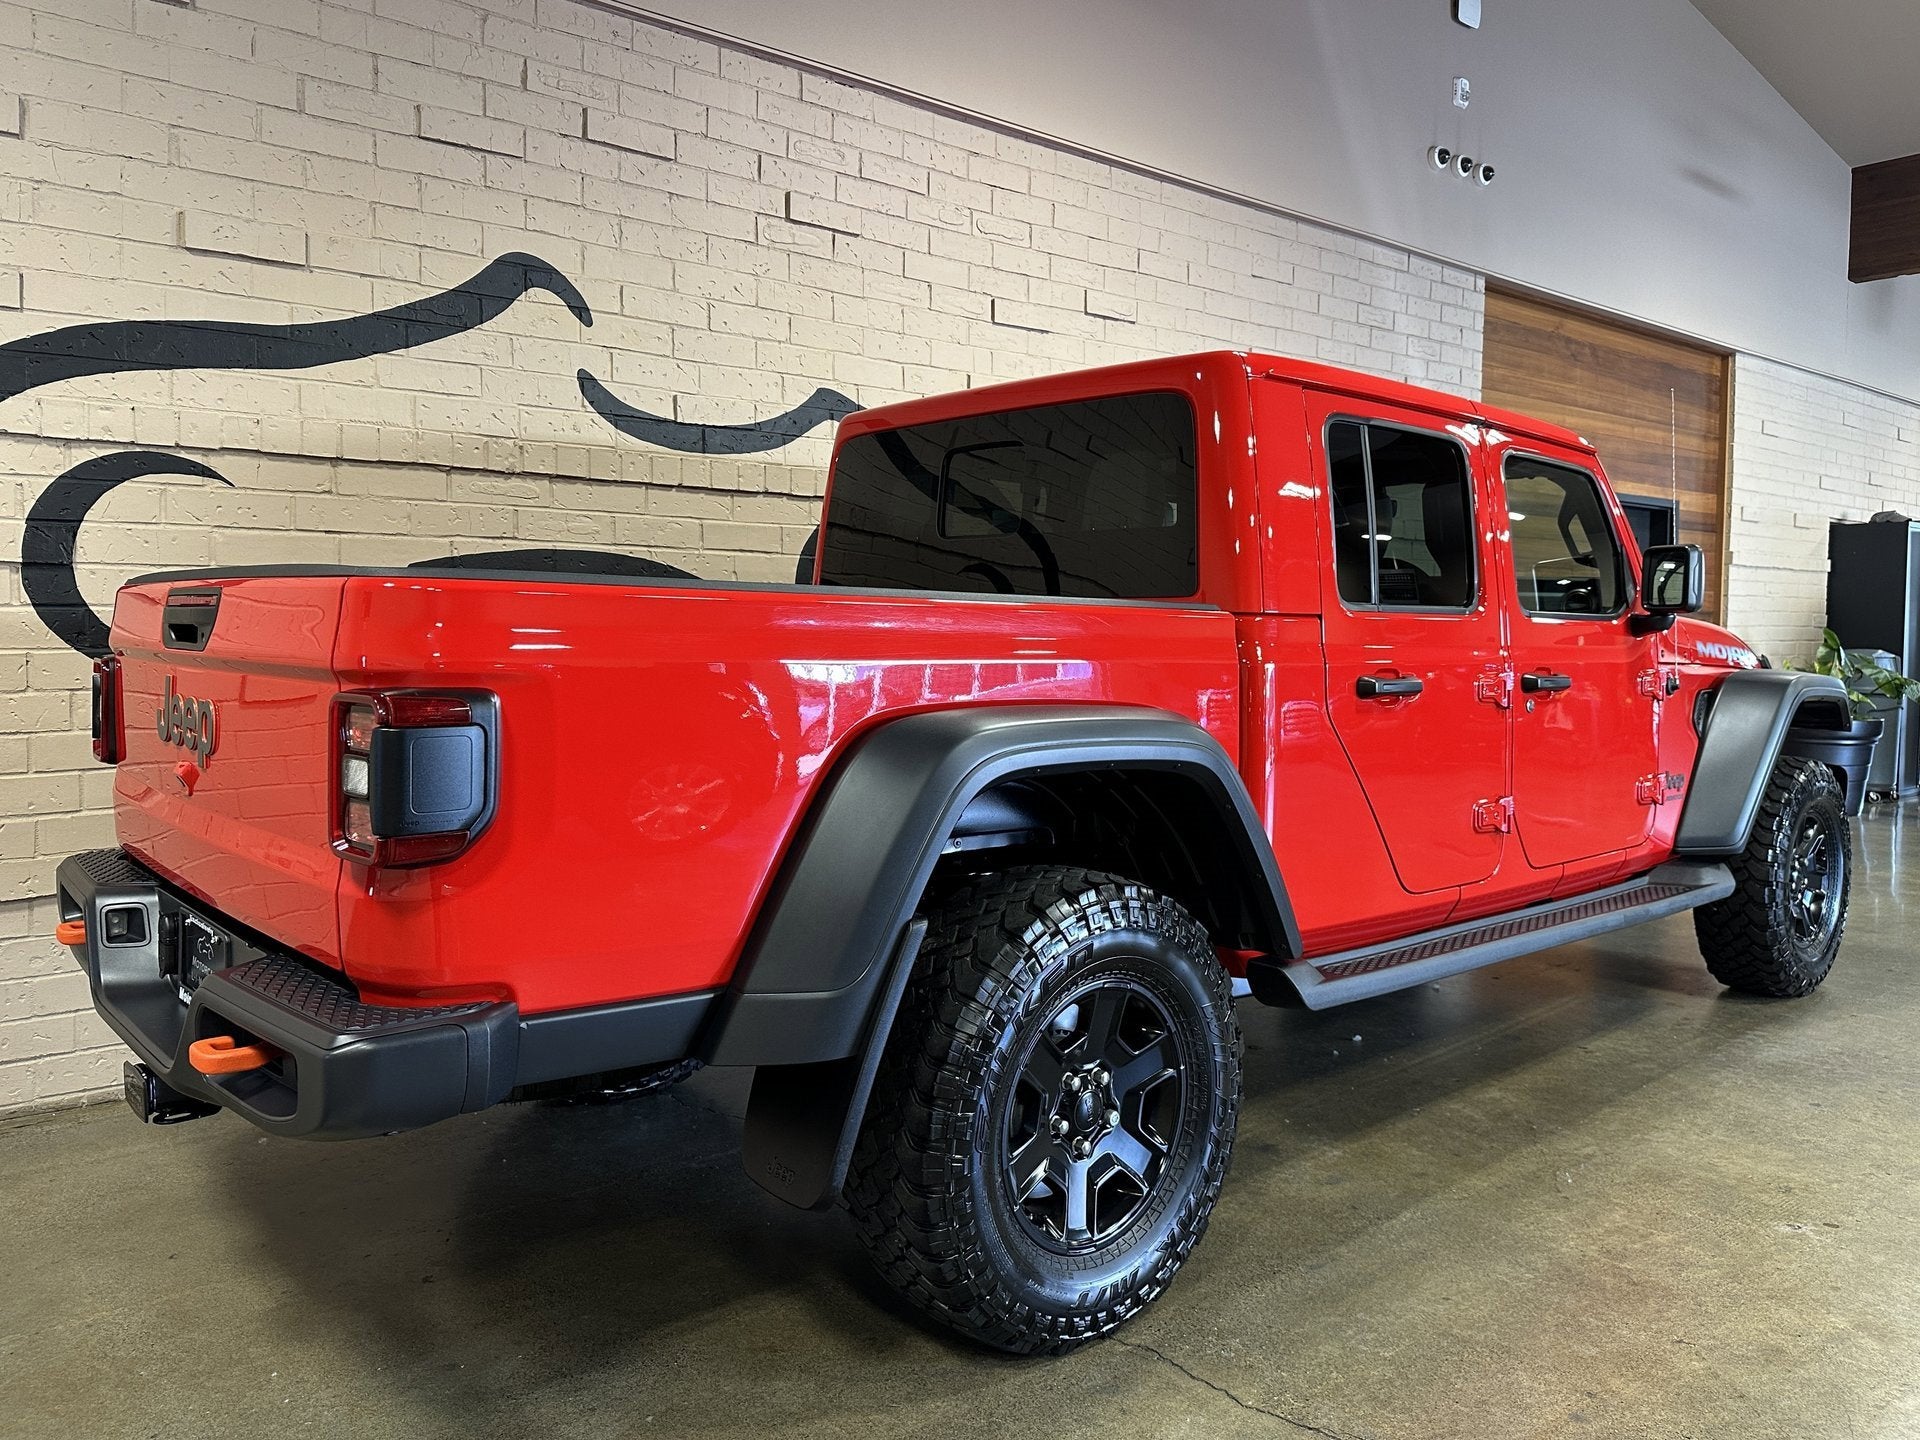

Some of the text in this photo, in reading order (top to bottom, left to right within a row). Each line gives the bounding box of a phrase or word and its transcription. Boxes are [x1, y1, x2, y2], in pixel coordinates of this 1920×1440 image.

[157, 674, 219, 768] Jeep
[1070, 1001, 1226, 1310] WILDPEAK M/T
